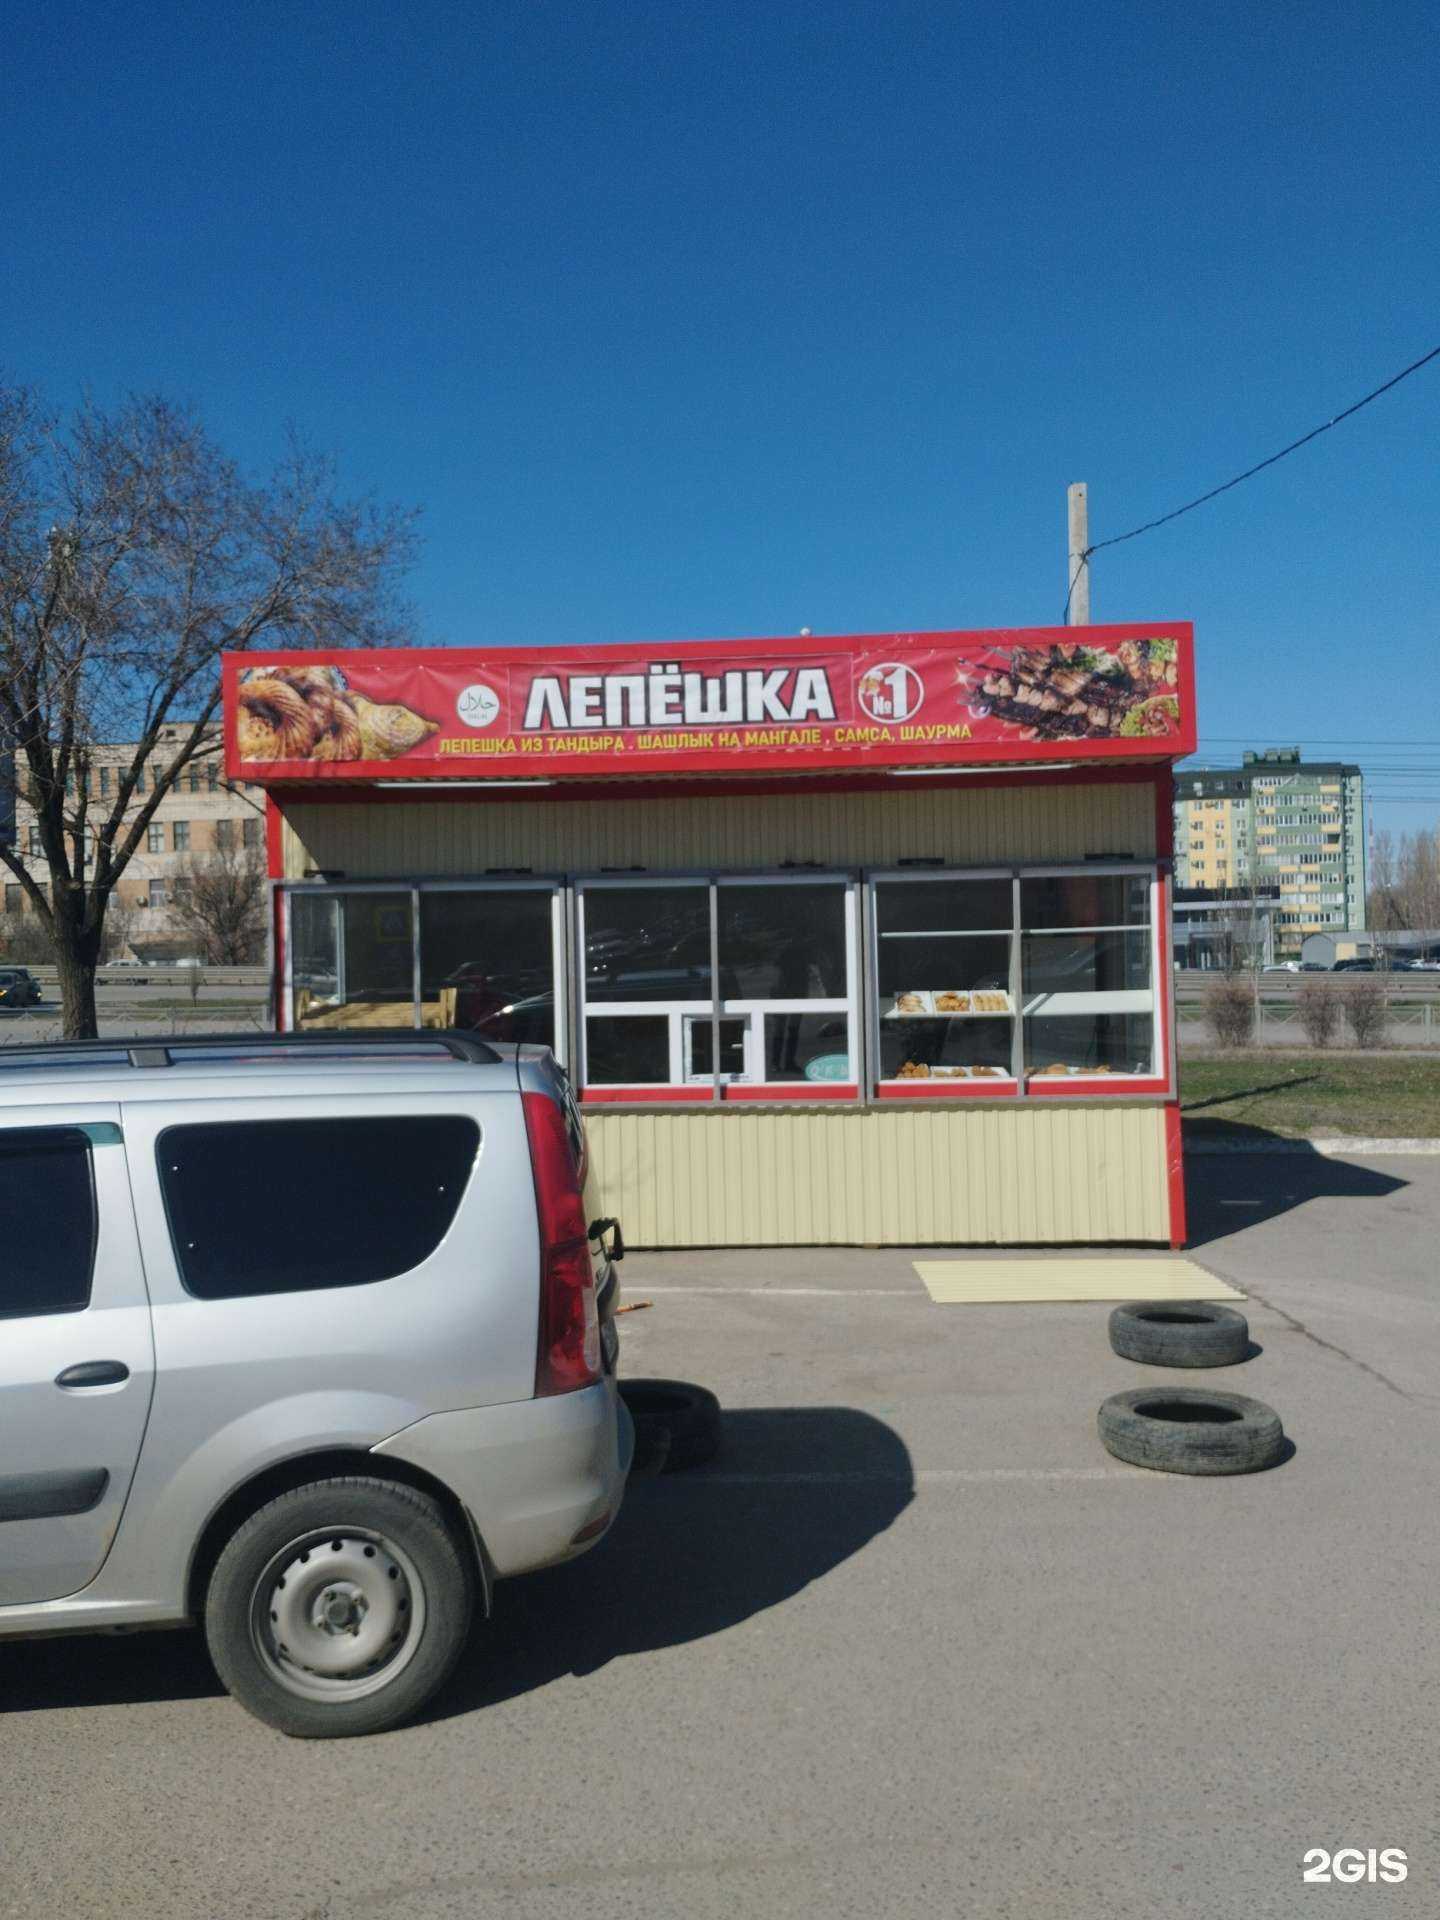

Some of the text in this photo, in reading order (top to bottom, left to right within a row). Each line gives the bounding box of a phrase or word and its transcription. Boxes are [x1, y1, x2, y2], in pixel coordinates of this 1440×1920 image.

[522, 662, 836, 730] ЛЕПЁШКА
[439, 737, 517, 754] ЛЕПЕШКА
[520, 737, 543, 752] ИЗ
[637, 731, 714, 749] ШАШЛЫК
[718, 731, 739, 747] НА
[900, 724, 972, 741] ШАУРМА
